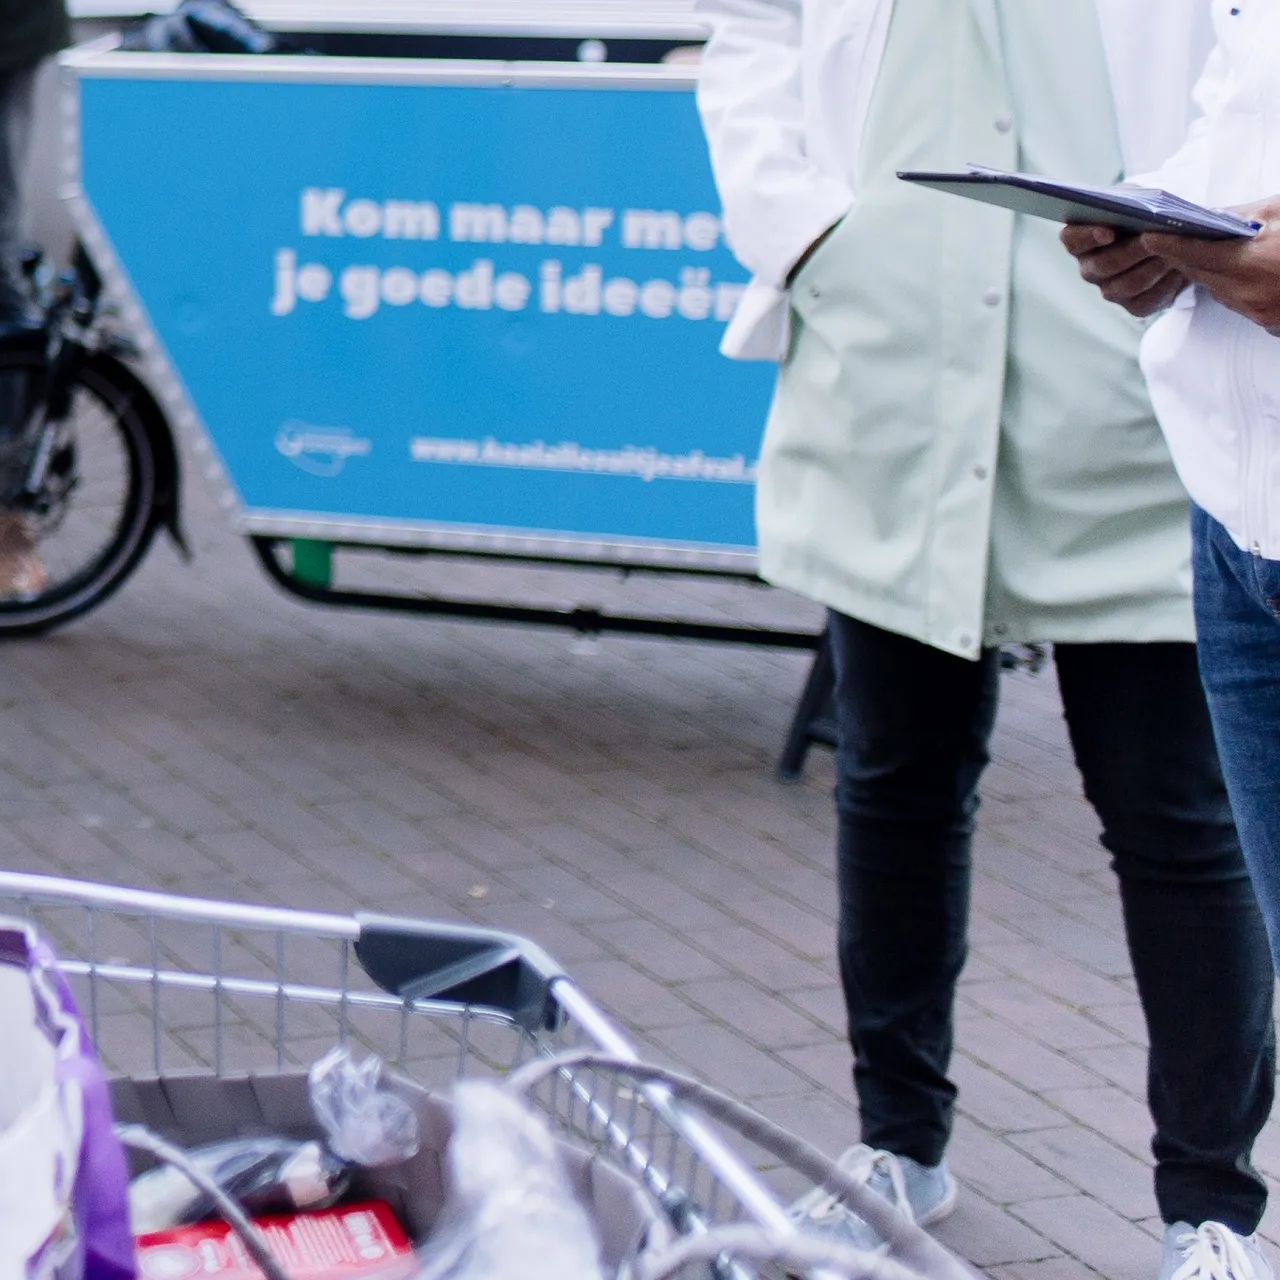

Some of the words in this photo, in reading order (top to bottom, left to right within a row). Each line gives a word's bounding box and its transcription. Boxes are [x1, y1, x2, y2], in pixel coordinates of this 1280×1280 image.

[300, 187, 439, 240] Kom
[449, 202, 613, 247] maar
[271, 248, 333, 316] je
[341, 259, 530, 320] goede
